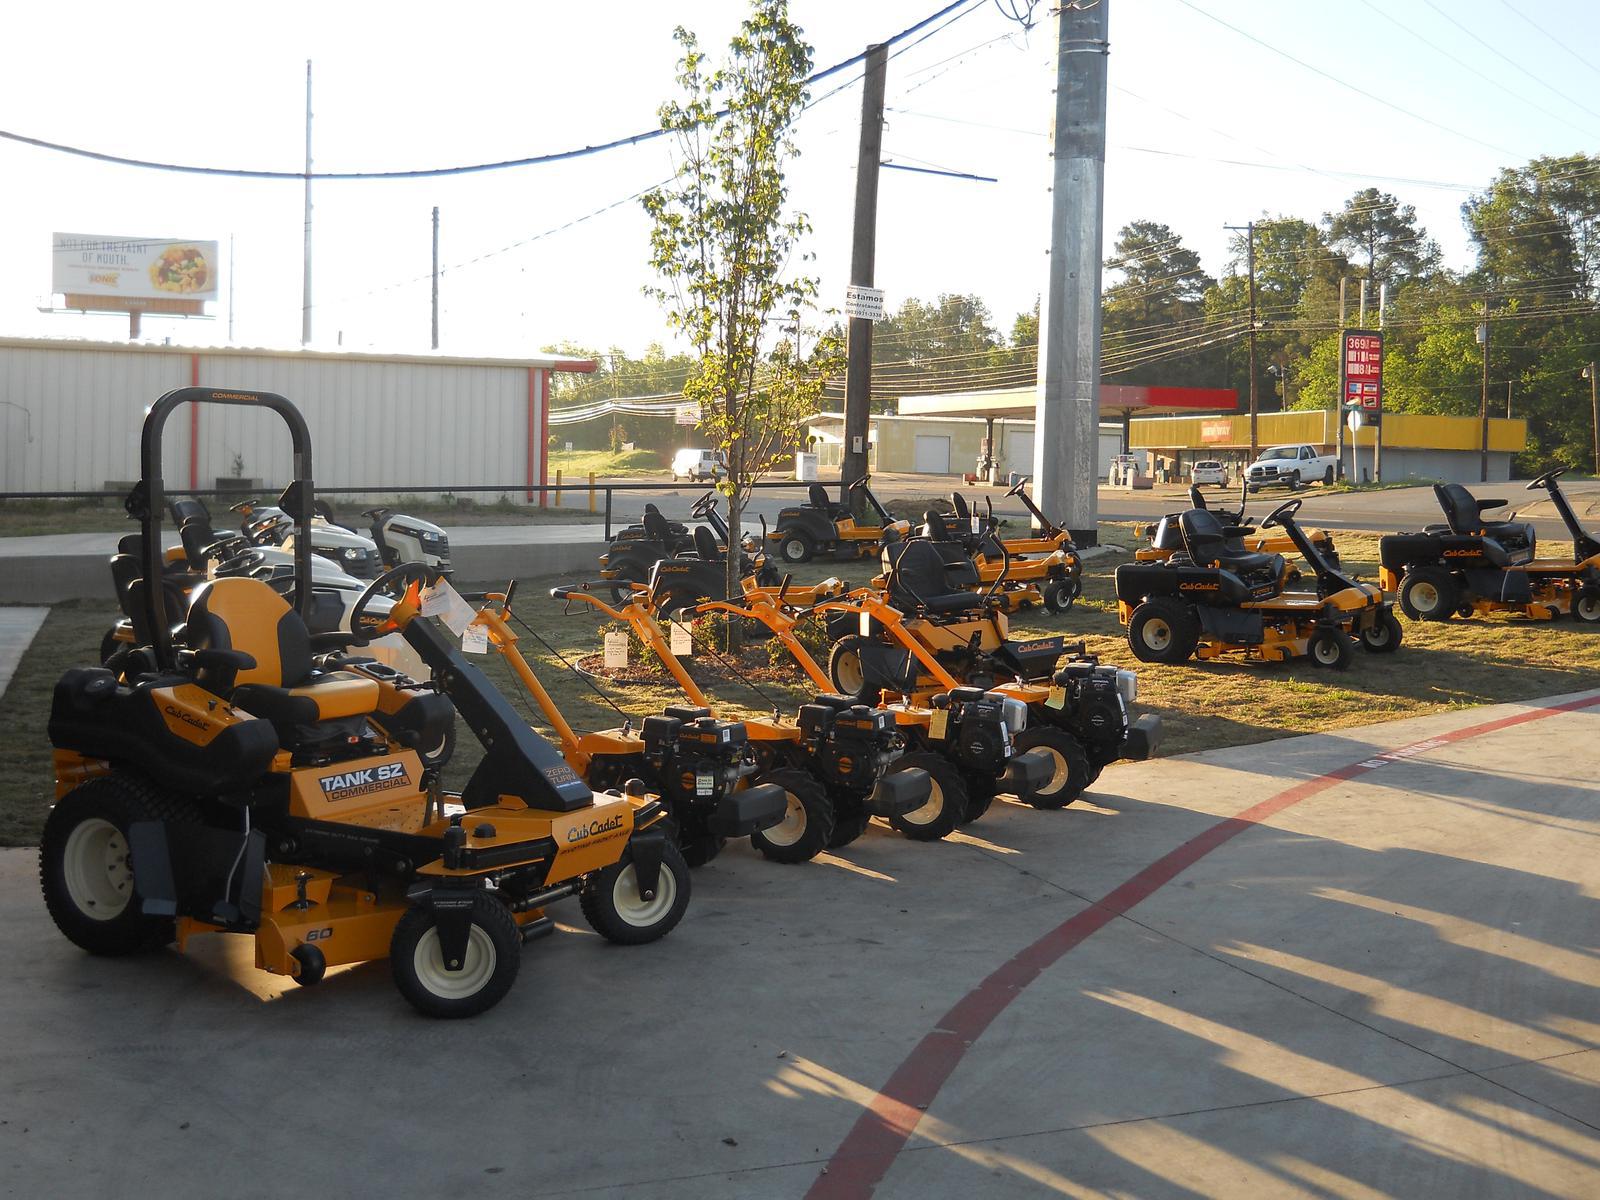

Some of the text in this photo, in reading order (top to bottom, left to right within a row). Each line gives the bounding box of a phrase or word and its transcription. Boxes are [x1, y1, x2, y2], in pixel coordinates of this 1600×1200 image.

[102, 241, 120, 253] THE
[82, 252, 94, 263] OF
[846, 291, 884, 303] Estamos
[1195, 583, 1220, 591] Cadet
[1032, 641, 1056, 651] Cadet
[164, 705, 210, 731] Cub Cadet
[321, 763, 403, 792] TANK SZ
[545, 766, 571, 778] ZERO
[331, 778, 407, 800] COMMERCIAL
[567, 814, 623, 843] Cub Cadet
[305, 927, 333, 942] 60
